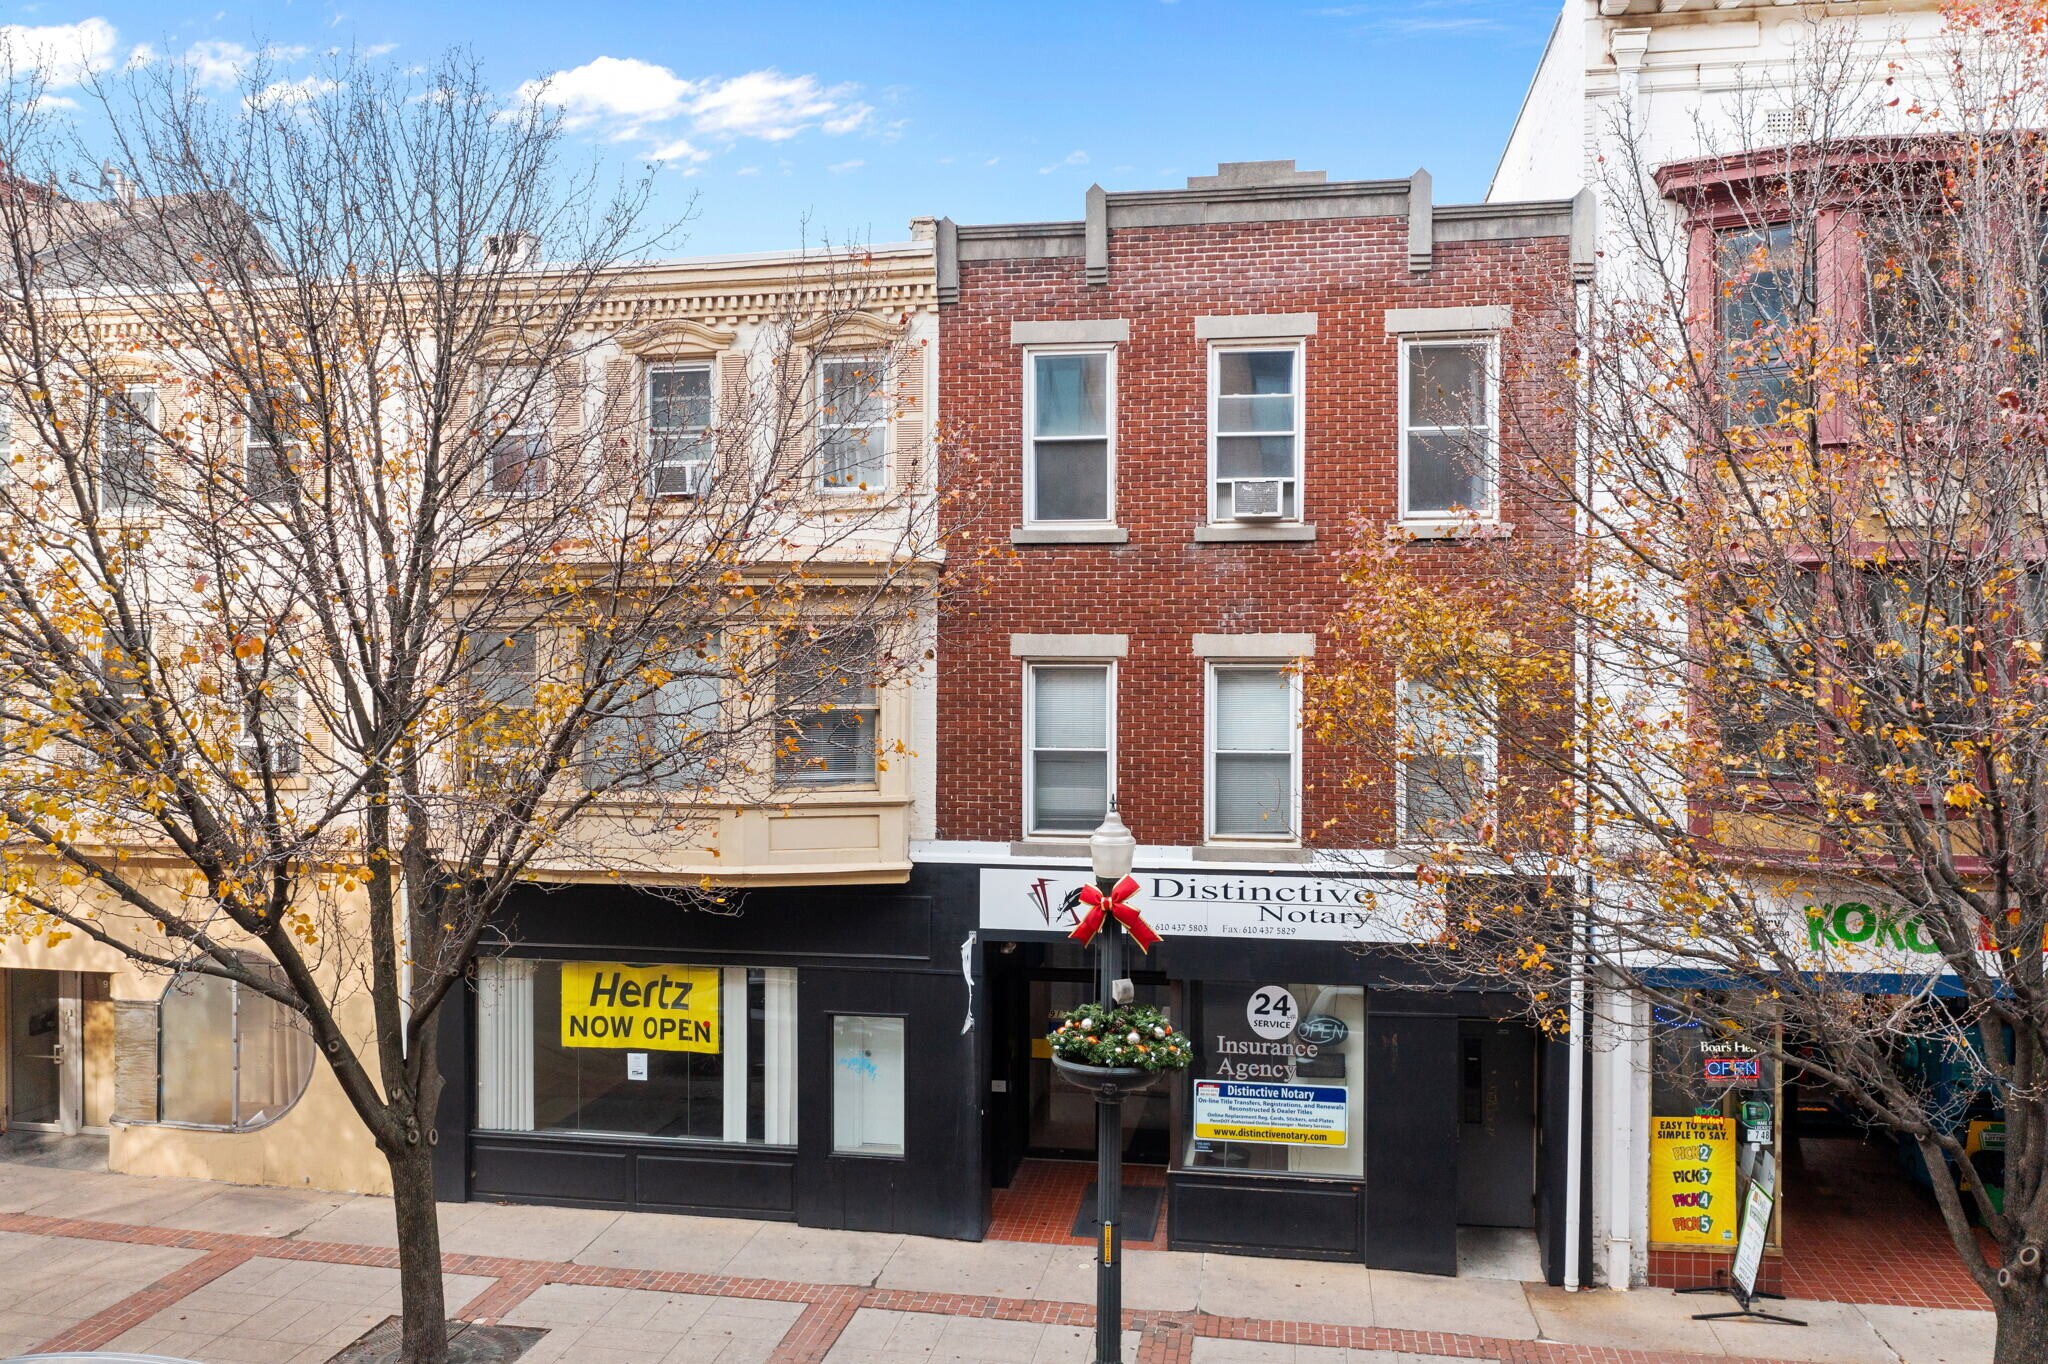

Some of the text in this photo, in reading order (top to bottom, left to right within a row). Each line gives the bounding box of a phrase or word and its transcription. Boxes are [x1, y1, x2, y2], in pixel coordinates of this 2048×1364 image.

[1151, 878, 1375, 903] Distinctive
[1257, 905, 1372, 929] Notary
[1154, 923, 1208, 933] 610 437 5803
[1242, 925, 1257, 934] 610
[1259, 926, 1276, 934] 437
[1277, 927, 1296, 935] 5829
[1803, 902, 1945, 954] KOKO
[589, 972, 693, 1010] Hertz
[1254, 993, 1291, 1017] 24
[569, 1015, 711, 1043] NOW OPEN
[1253, 1019, 1291, 1029] SERVICE
[1298, 1022, 1345, 1039] OPEN
[1216, 1035, 1318, 1058] Insurance
[1216, 1057, 1297, 1083] Agency
[1707, 1062, 1757, 1076] OPEN
[1227, 1085, 1315, 1101] Distinctive Notary
[1228, 1105, 1271, 1113] Reconstructed
[1234, 1099, 1262, 1107] Transfers,
[1262, 1101, 1303, 1109] Registrations,
[1660, 1121, 1683, 1130] EASY
[1686, 1121, 1698, 1130] TO
[1214, 1127, 1327, 1142] www.distinctivenotary.com
[1657, 1131, 1729, 1141] SIMPLE TO SAY.
[1672, 1145, 1709, 1160] PICK 2
[1672, 1169, 1709, 1184] PICK 3
[1672, 1192, 1709, 1207] PICK 4
[1672, 1216, 1709, 1231] PICK 5
